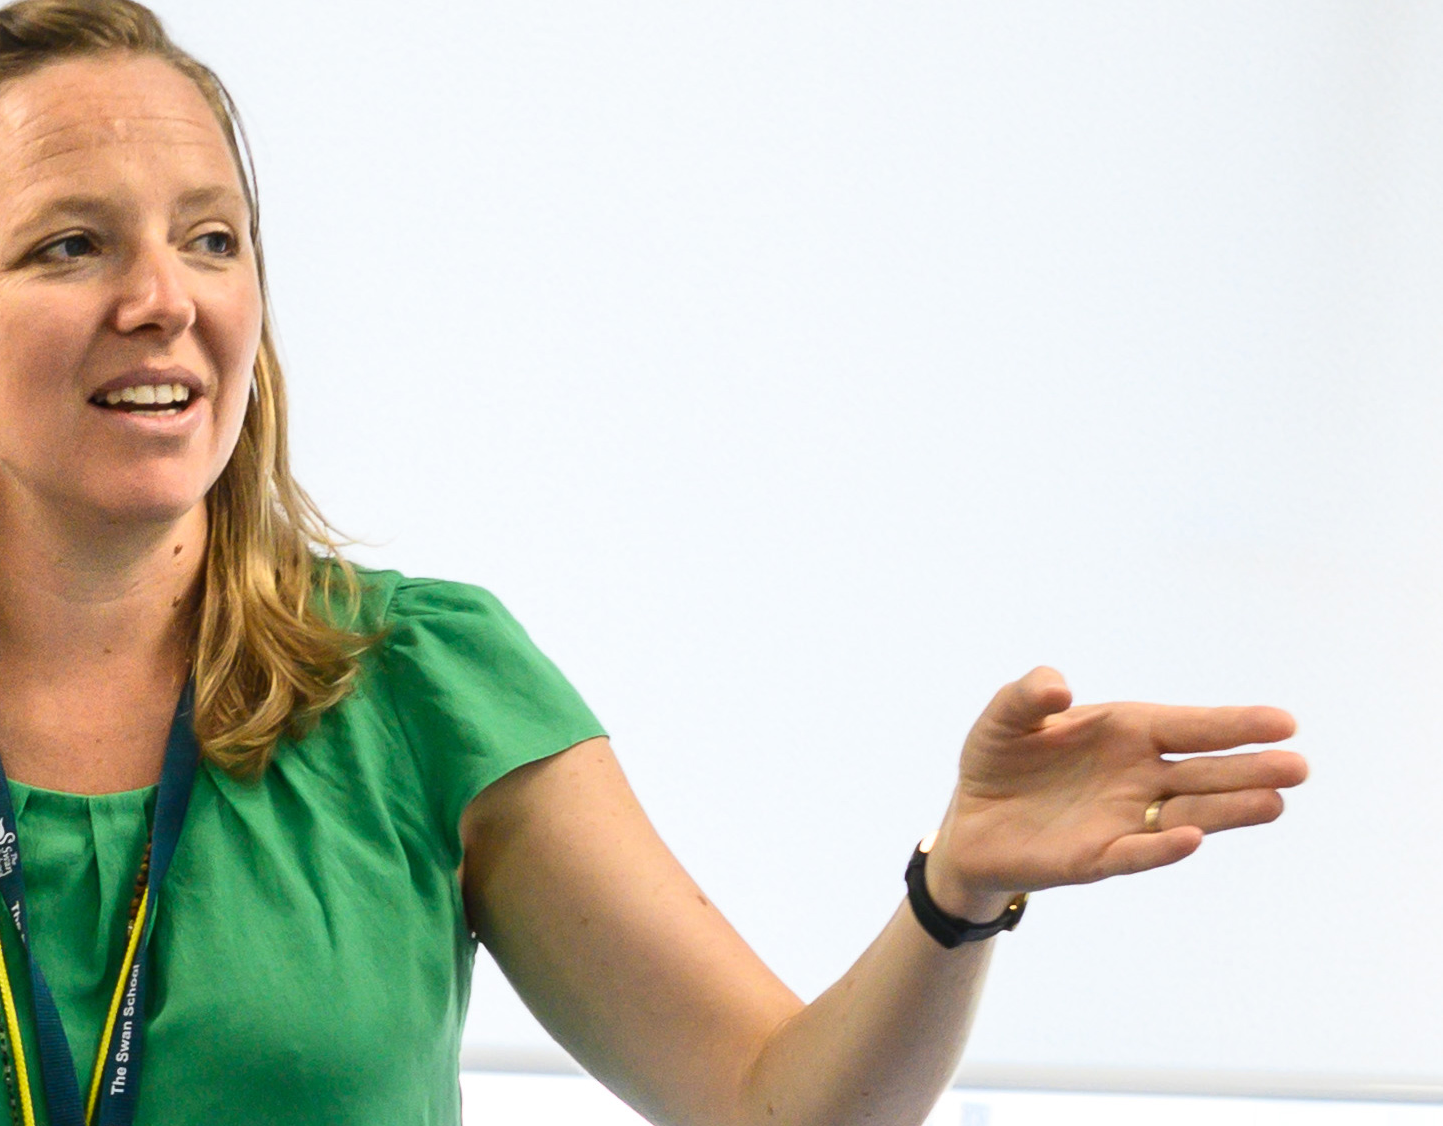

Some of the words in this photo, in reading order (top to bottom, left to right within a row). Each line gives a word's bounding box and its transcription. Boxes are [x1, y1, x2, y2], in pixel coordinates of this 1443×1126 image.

[123, 964, 140, 1017] School
[115, 1020, 132, 1063] Swan
[110, 1066, 127, 1096] The
